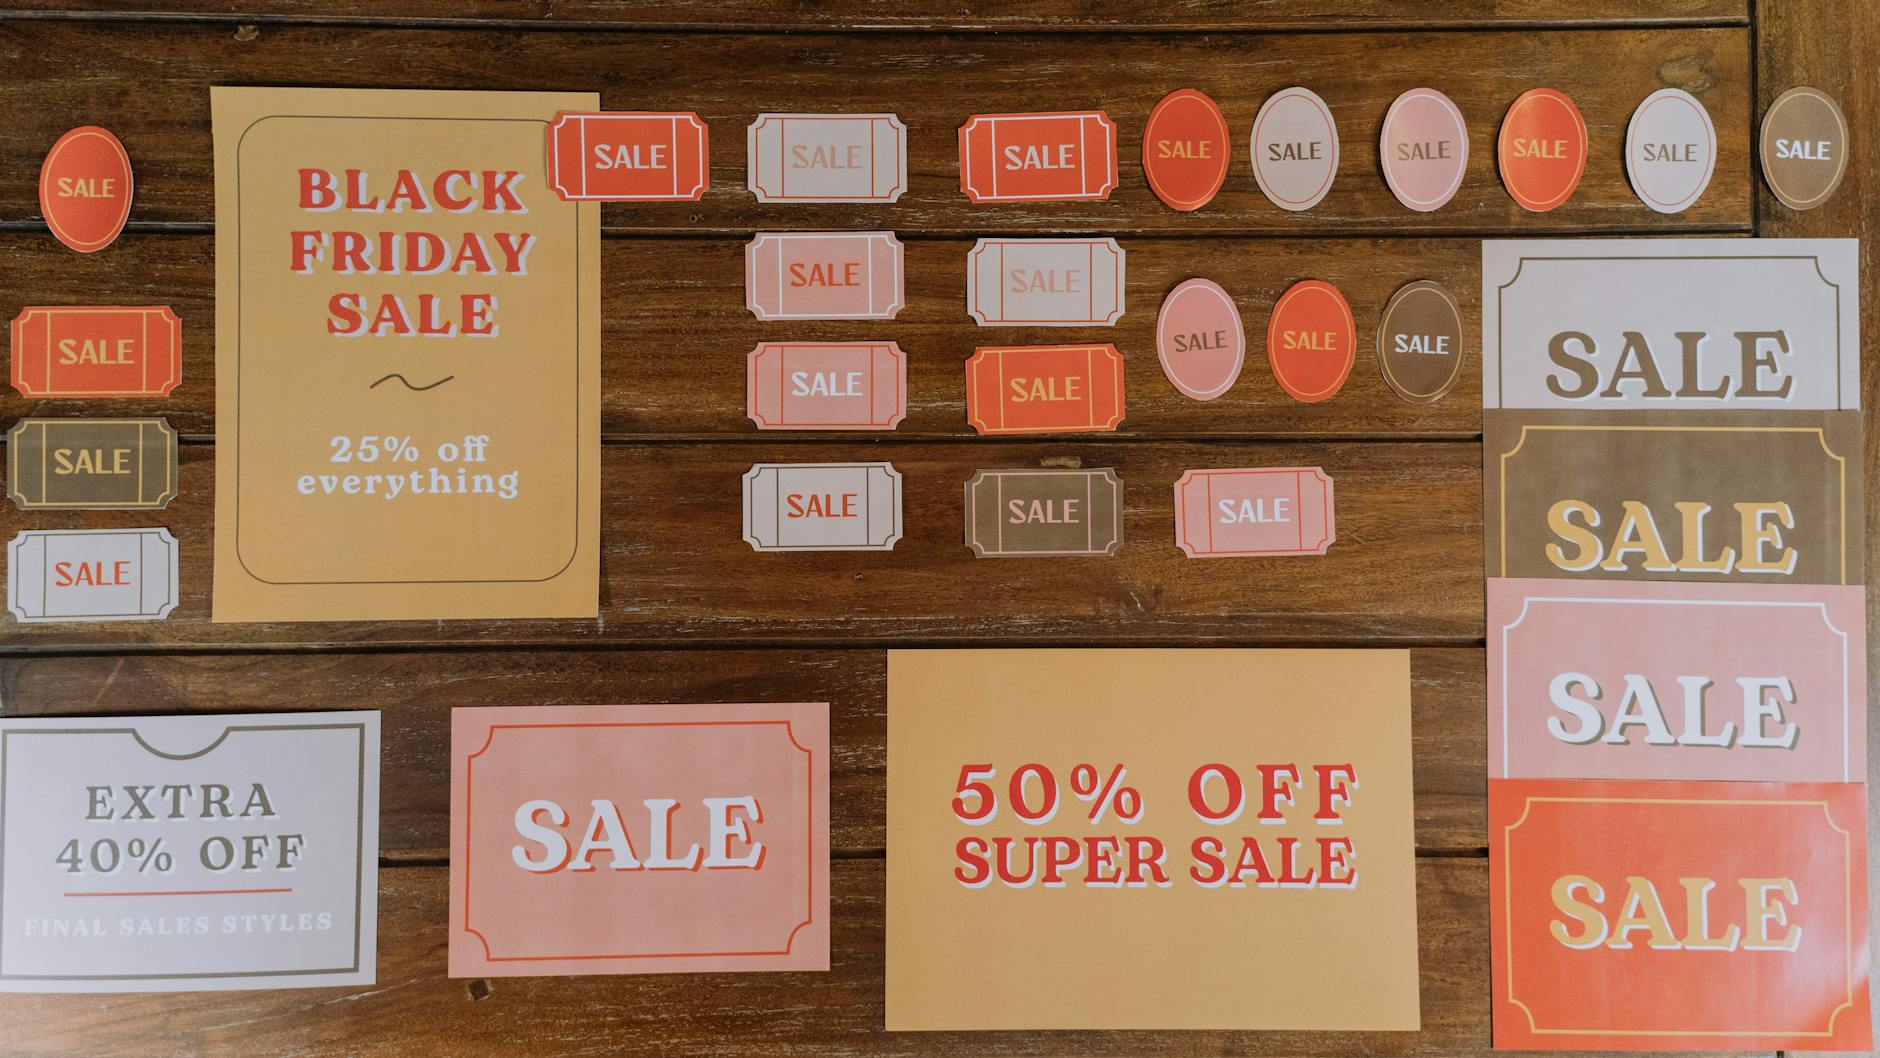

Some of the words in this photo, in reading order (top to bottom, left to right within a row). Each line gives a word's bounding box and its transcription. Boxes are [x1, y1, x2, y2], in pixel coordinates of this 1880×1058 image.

[594, 144, 667, 169] SALE
[792, 145, 862, 169] SALE
[1004, 144, 1075, 170] SALE
[1158, 140, 1211, 158] SALE
[1268, 142, 1321, 161] SALE
[1398, 141, 1451, 160] SALE
[1512, 138, 1569, 159] SALE
[1643, 144, 1697, 162] SALE
[1776, 139, 1831, 160] SALE
[58, 177, 114, 198] SALE
[298, 168, 528, 214] BLACK
[290, 230, 536, 276] FRIDAY
[789, 263, 860, 287] SALE
[1011, 269, 1080, 294] SALE
[327, 293, 499, 338] SALE
[59, 339, 134, 365] SALE
[1174, 330, 1228, 352] SALE
[1283, 331, 1337, 350] SALE
[1395, 334, 1450, 354] SALE
[1546, 330, 1795, 402] SALE
[792, 372, 862, 396] SALE
[1011, 377, 1081, 402] SALE
[330, 435, 419, 462] 25%
[438, 435, 490, 462] off
[54, 449, 130, 474] SALE
[297, 467, 518, 499] everything
[787, 494, 858, 518] SALE
[1009, 499, 1079, 524] SALE
[1219, 498, 1290, 524] SALE
[1546, 500, 1797, 575] SALE
[55, 561, 130, 587] SALE
[1548, 672, 1800, 751] SALE
[86, 783, 278, 822] EXTRA
[952, 763, 1144, 825] 50%
[1188, 763, 1359, 825] OFF
[512, 796, 766, 874] SALE
[56, 837, 175, 874] 40%
[200, 834, 307, 872] OFF
[954, 836, 1173, 888] SUPER
[1190, 836, 1358, 889] SALE
[24, 918, 107, 937] FINAL
[119, 917, 209, 936] SALES
[222, 912, 333, 933] STYLES
[1550, 875, 1802, 953] SALE
